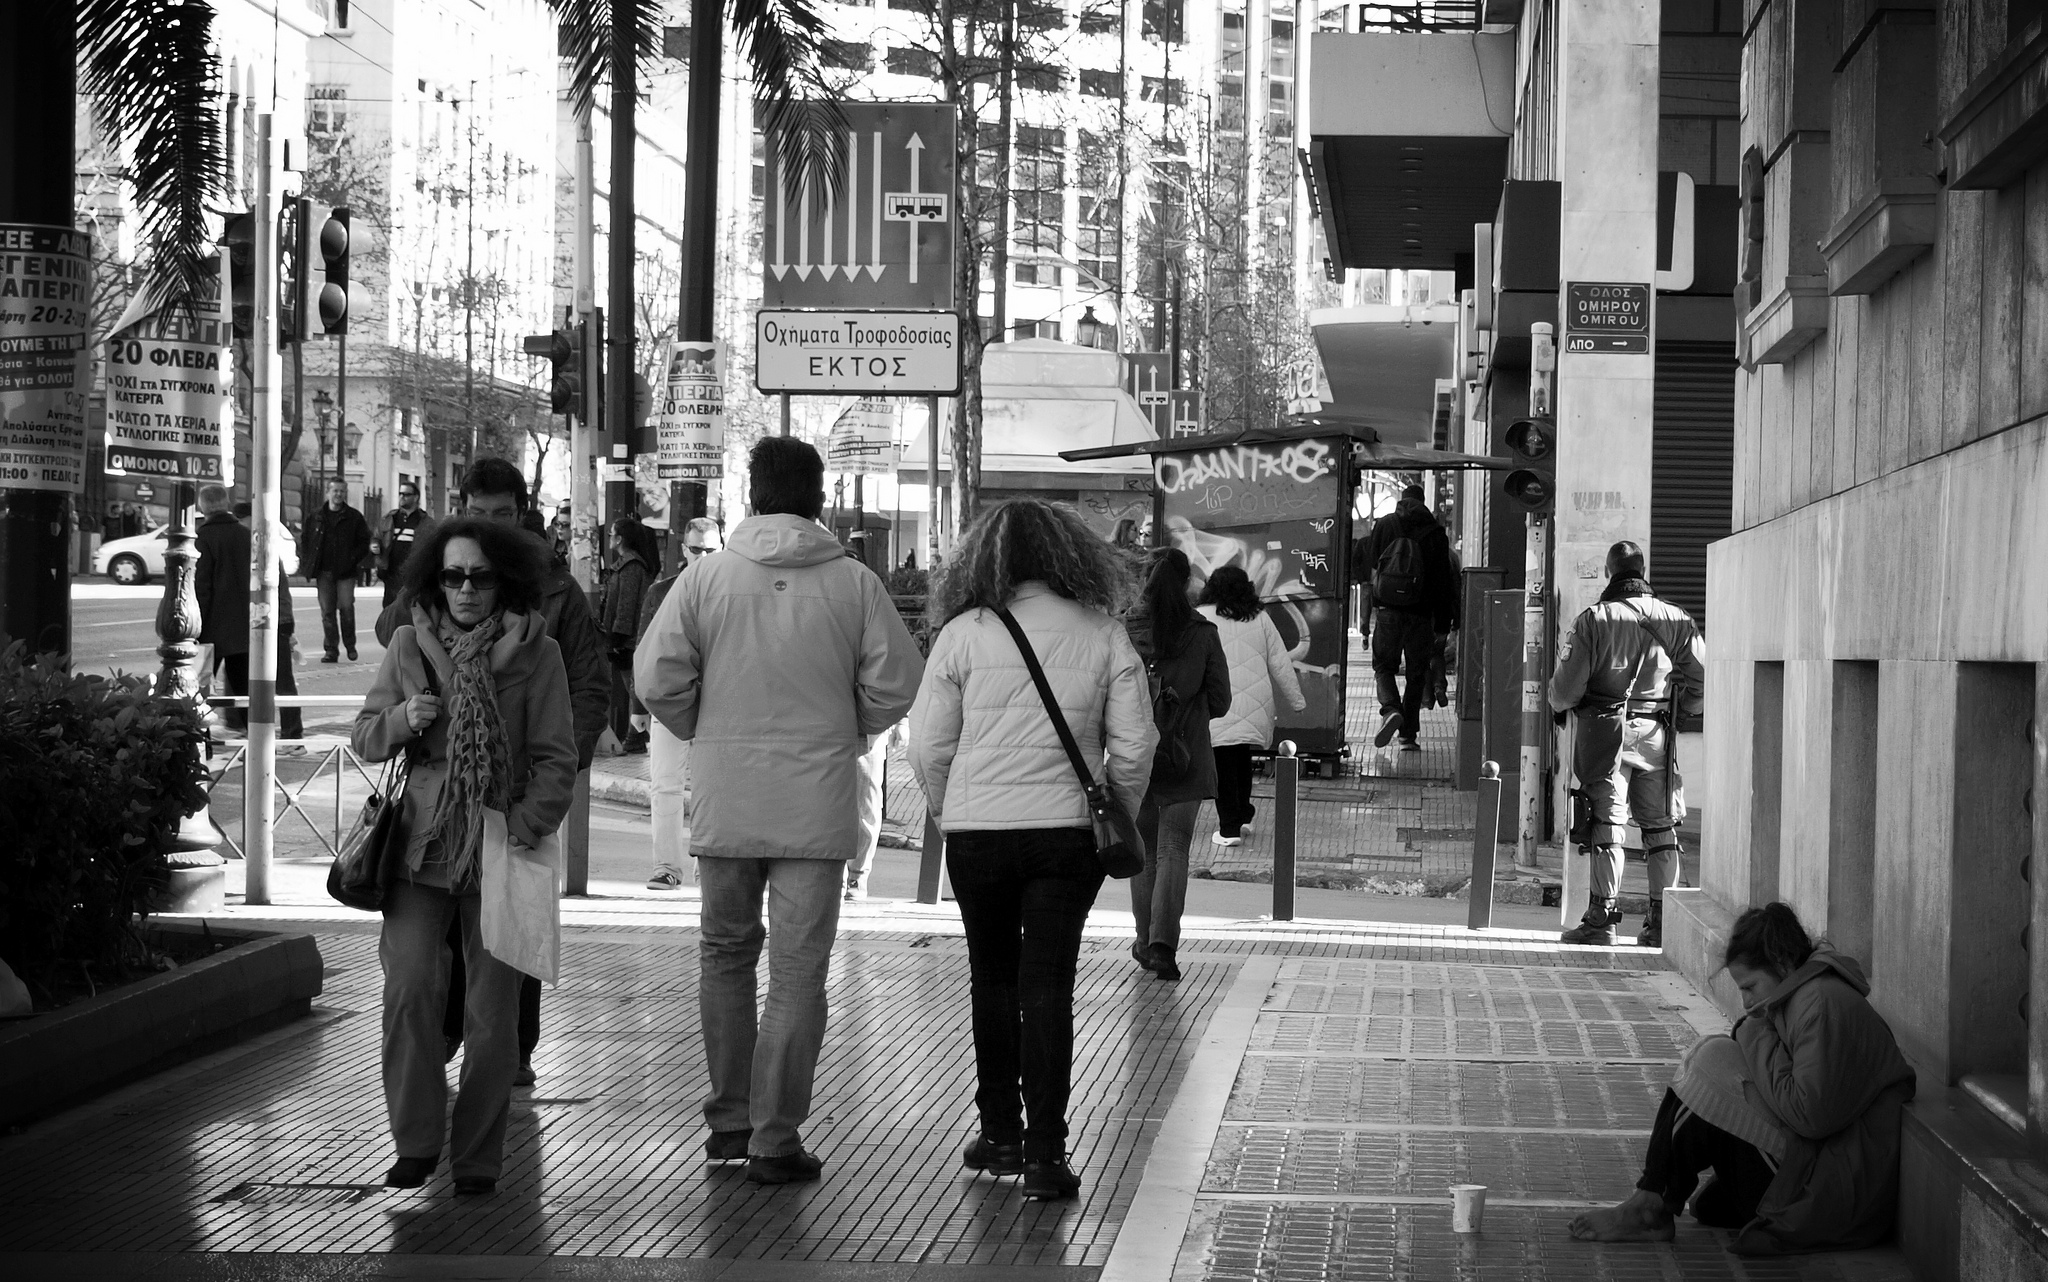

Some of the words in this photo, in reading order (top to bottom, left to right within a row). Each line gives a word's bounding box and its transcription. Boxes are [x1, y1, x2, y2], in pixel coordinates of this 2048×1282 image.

[1579, 300, 1641, 313] ΟΜΗΡΟΥ
[1580, 314, 1639, 325] OMIROU
[764, 320, 840, 347] Οχήματα
[844, 320, 952, 349] Τροφοδοσίας
[1569, 339, 1595, 350] ΑΠΟ
[111, 340, 143, 366] 20
[150, 347, 219, 371] ΦΛΕΒΑ
[809, 356, 907, 377] ΕΚΤΟΣ
[115, 375, 137, 389] ΟΧΙ
[140, 381, 157, 390] ΣΤΑ
[160, 379, 215, 394] ΣΥΓΧΡΟΝΑ
[115, 390, 164, 405] ΚΑΤΕΡΓΑ
[116, 410, 151, 426] ΚΑΤΩ
[155, 413, 172, 427] ΤΑ
[175, 415, 207, 431] ΧΕΡΙΑ
[116, 426, 180, 442] ΣΥΛΛΟΓΙΚΕΣ
